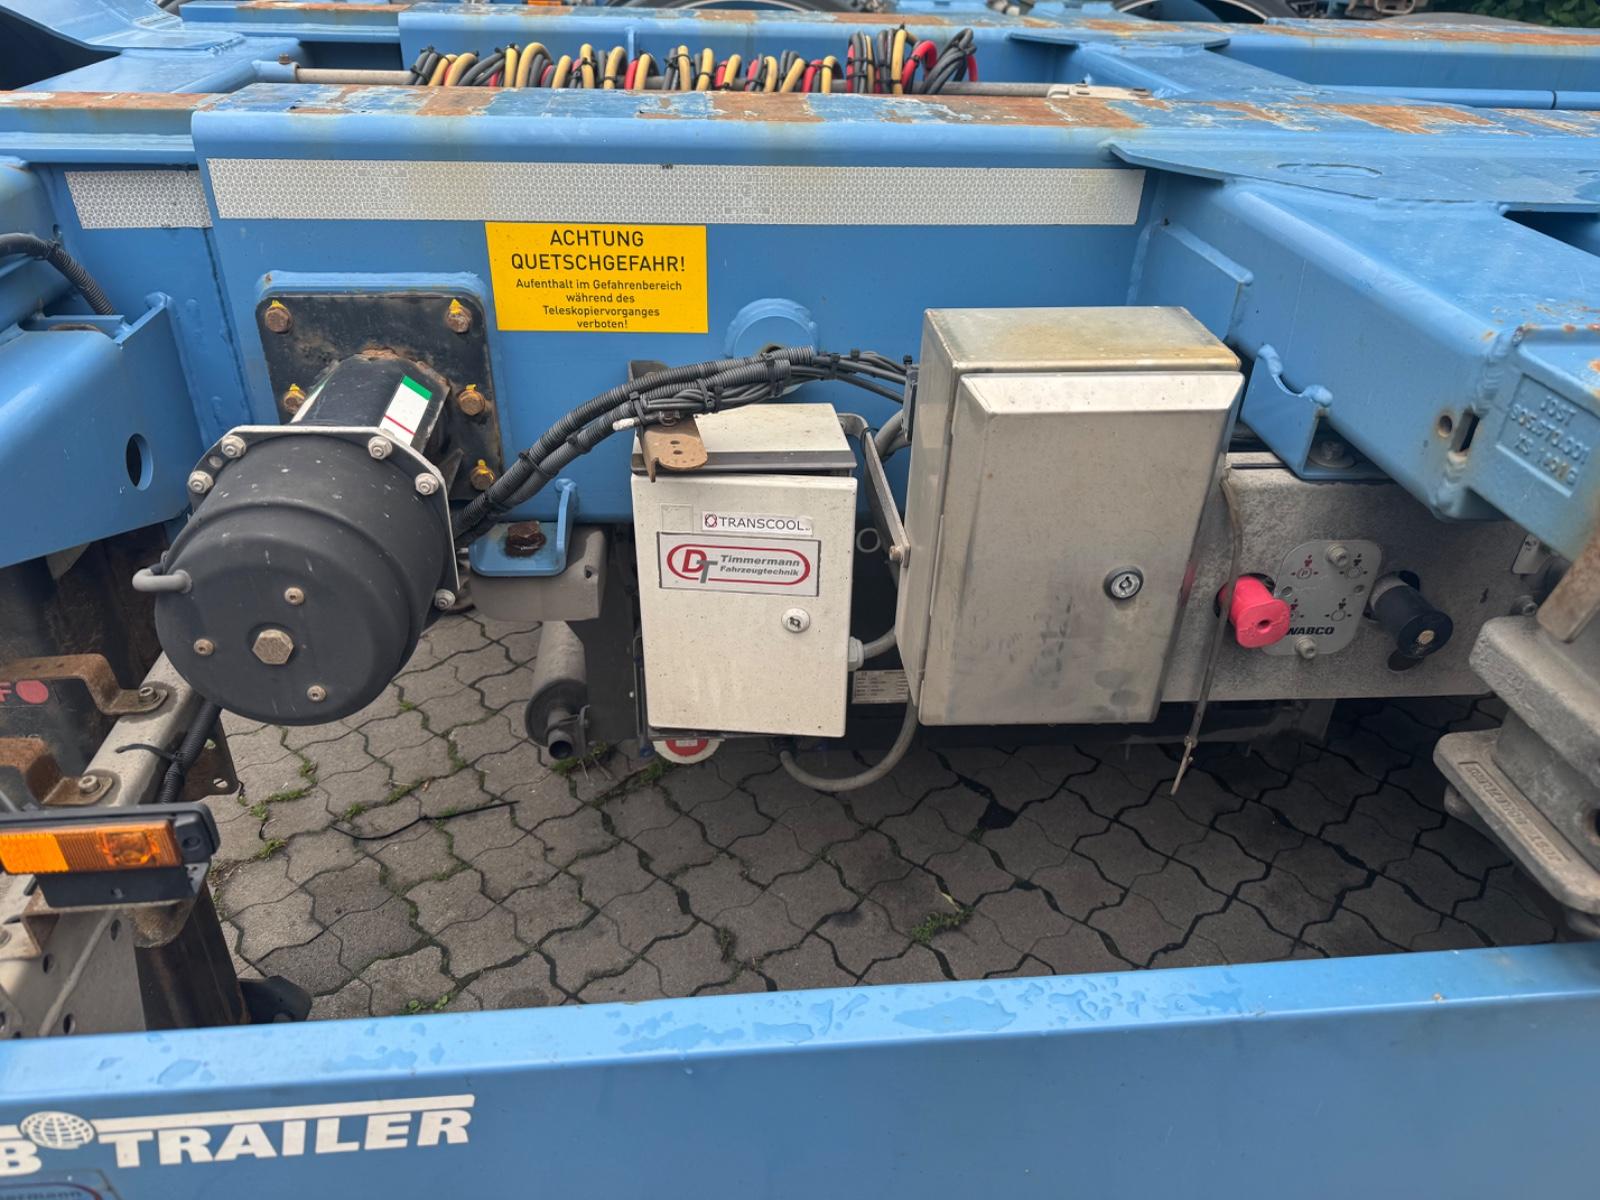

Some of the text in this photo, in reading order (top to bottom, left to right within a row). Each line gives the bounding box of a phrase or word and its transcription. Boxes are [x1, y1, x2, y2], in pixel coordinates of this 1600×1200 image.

[550, 229, 644, 247] ACHTUNG
[511, 253, 685, 272] QUETSCHGEFAHR!
[516, 279, 682, 291] Aufenthalt im Gefahrenbereich
[566, 293, 635, 303] während des
[543, 305, 660, 318] Teleskopiervorganges
[577, 319, 628, 329] verboten!
[719, 516, 804, 531] TRANSCOOL
[720, 554, 800, 567] Timmermann
[720, 565, 799, 577] Fahrzeugtechnik
[98, 1109, 472, 1168] TRAILER
